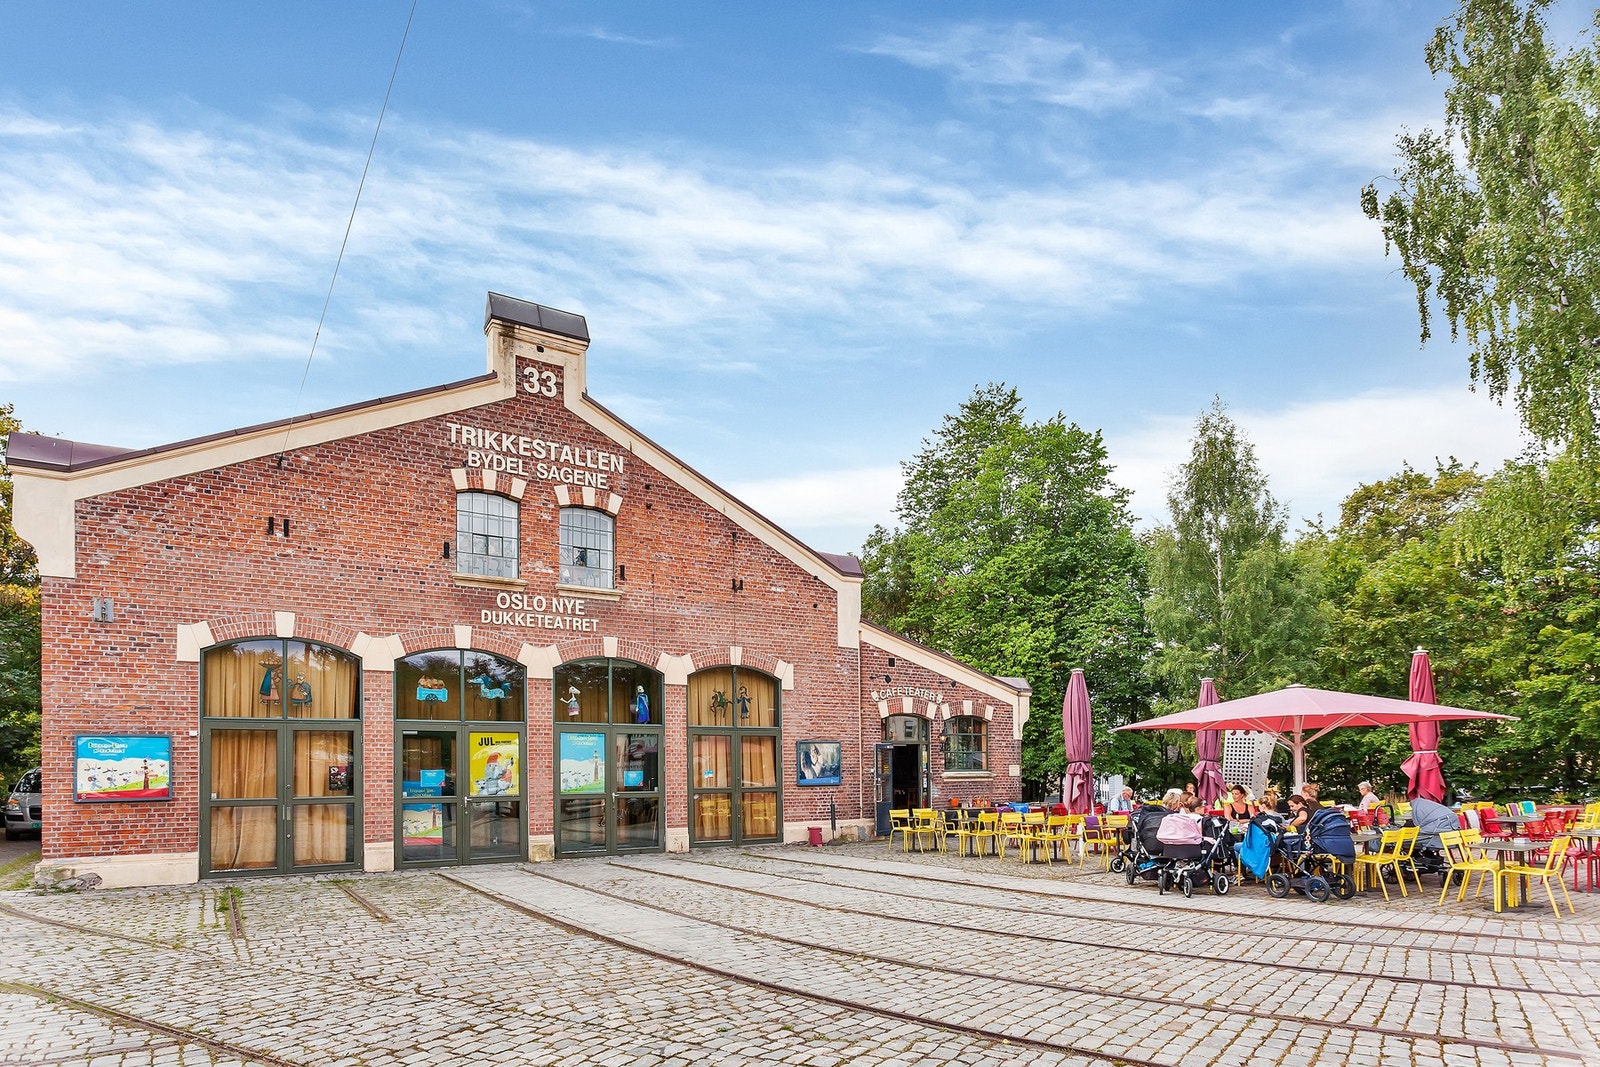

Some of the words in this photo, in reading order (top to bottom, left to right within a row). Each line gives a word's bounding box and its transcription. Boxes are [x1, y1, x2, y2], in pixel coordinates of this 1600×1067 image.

[523, 366, 558, 398] 33
[446, 422, 624, 474] TRIKKESTALLEN
[468, 450, 529, 476] BYDEL
[536, 463, 608, 490] SAGENE
[496, 592, 547, 612] OSLO
[552, 597, 586, 616] NYE
[481, 609, 600, 632] DUKKETEATRET
[478, 737, 496, 746] JUL
